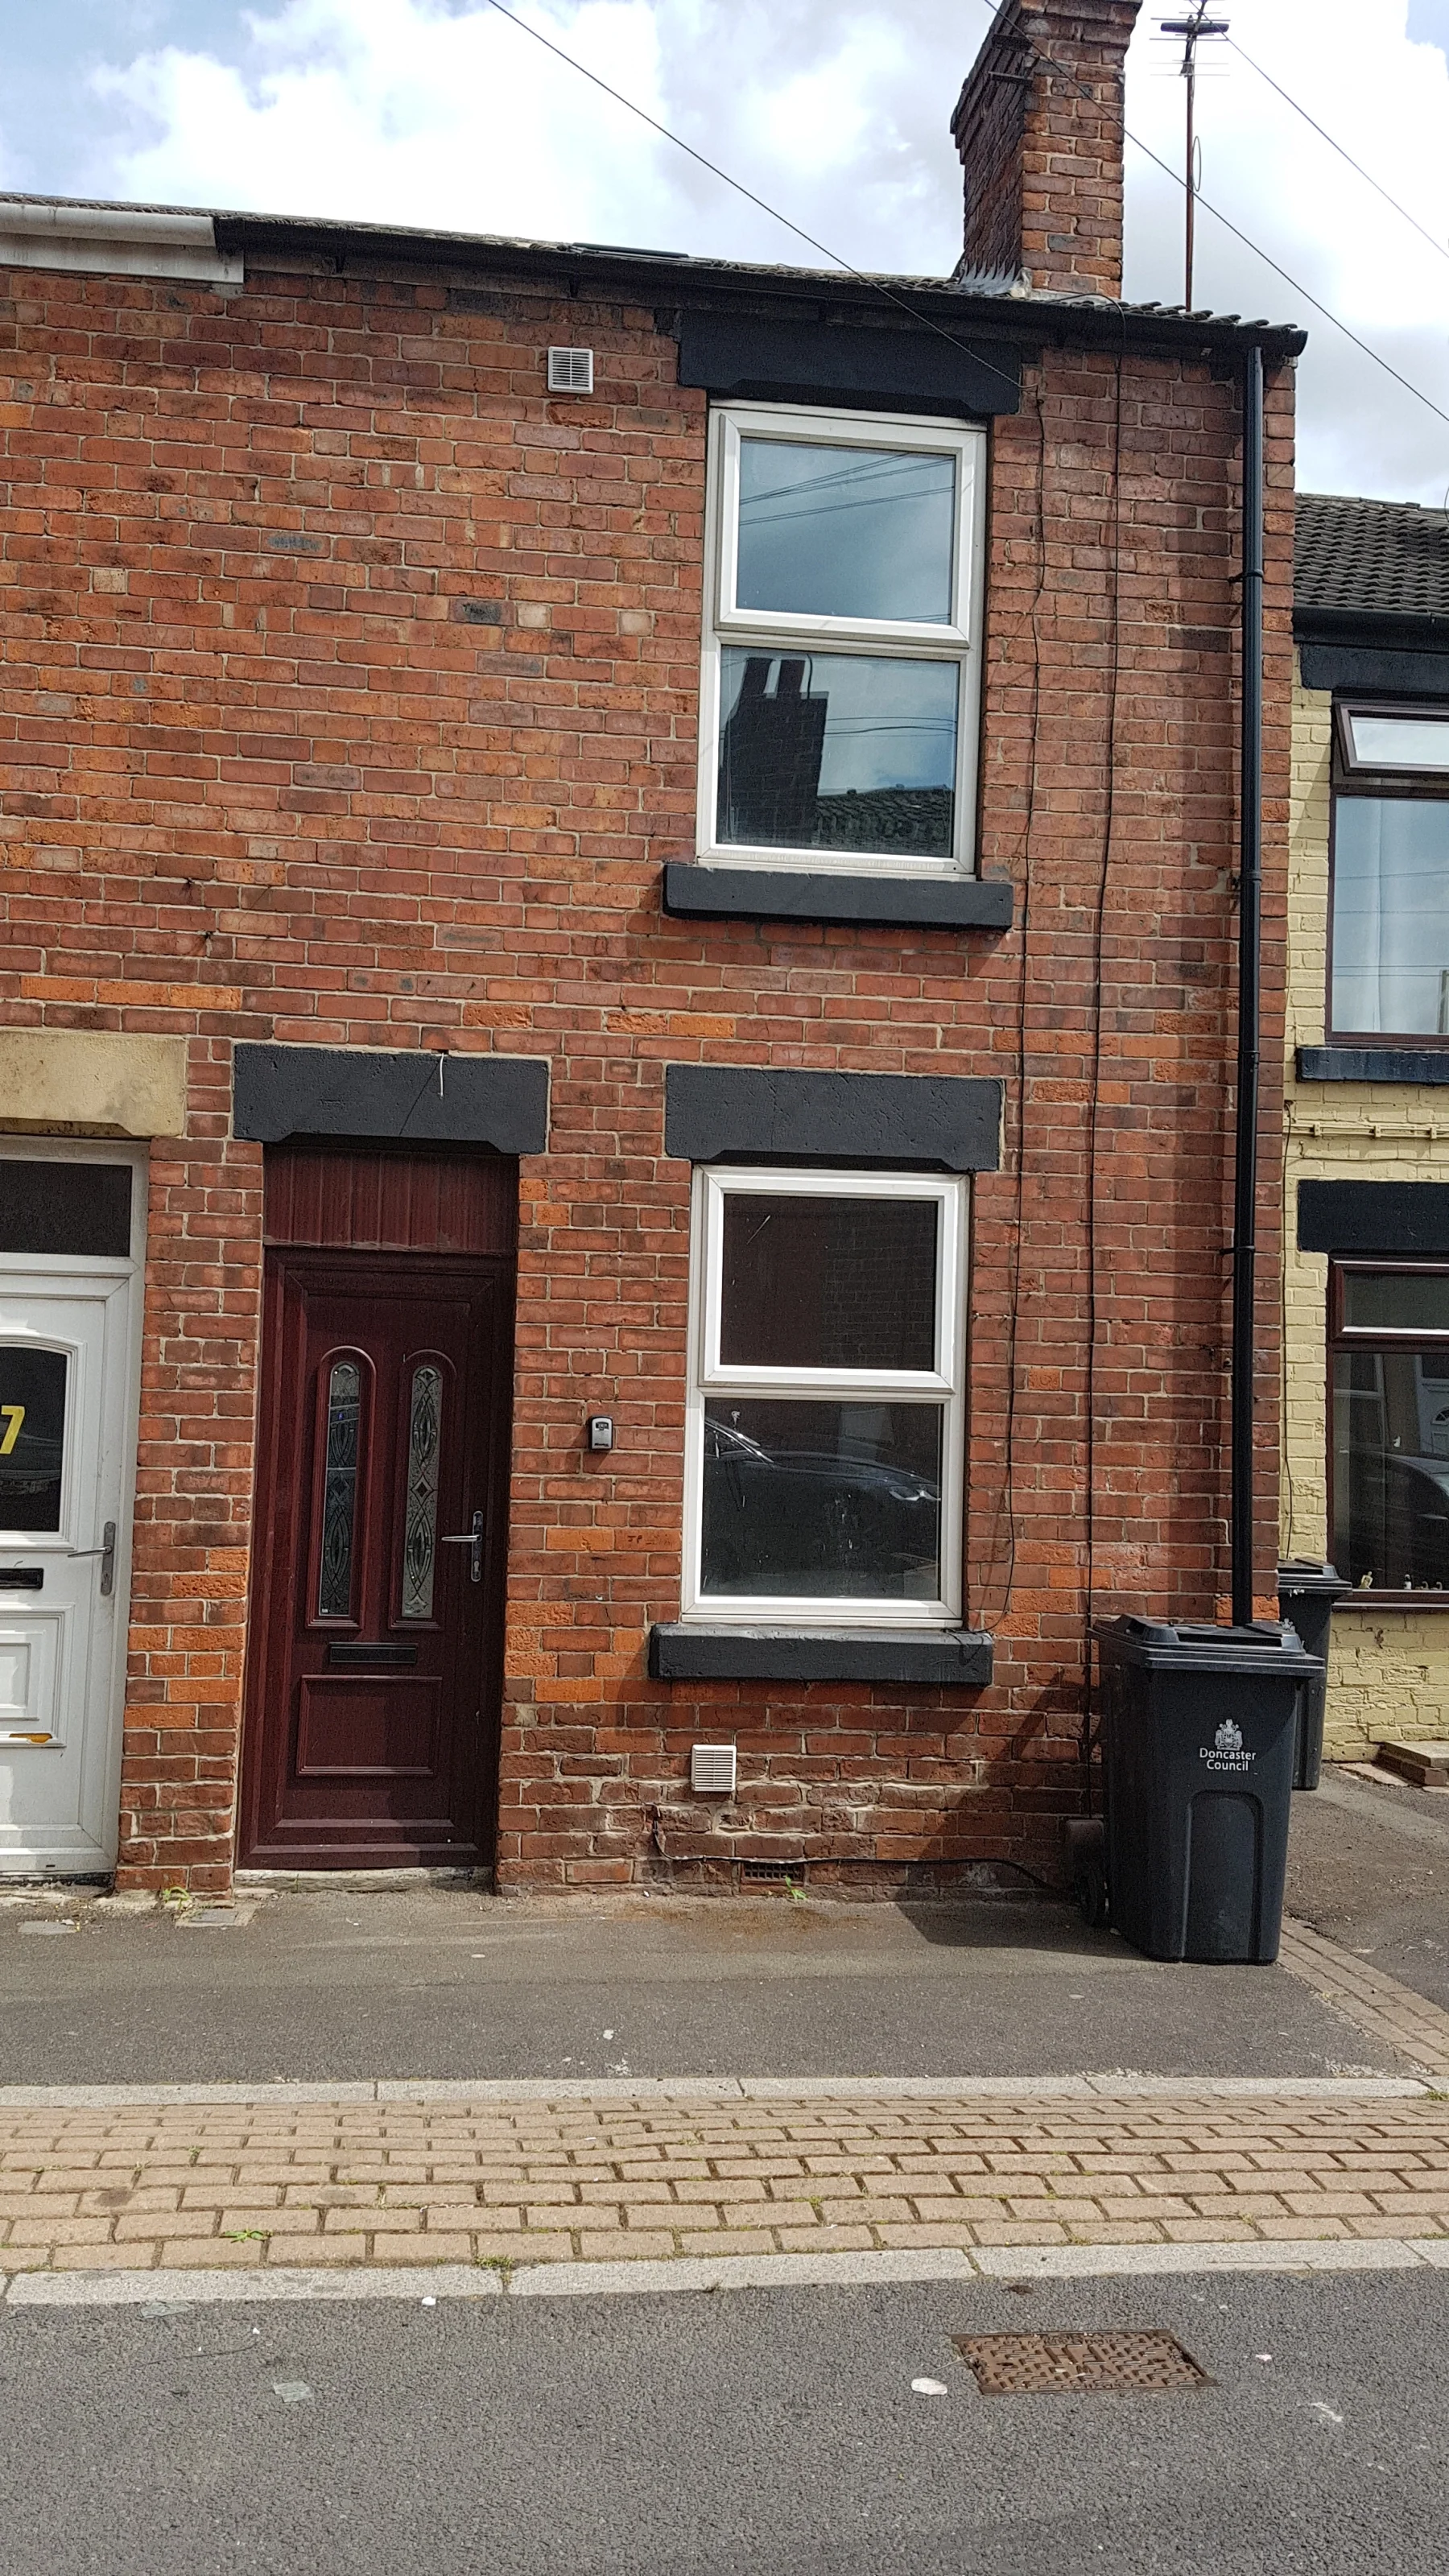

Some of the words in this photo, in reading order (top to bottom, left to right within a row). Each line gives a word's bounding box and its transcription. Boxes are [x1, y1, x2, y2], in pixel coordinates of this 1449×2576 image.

[0, 1405, 25, 1455] 7
[1199, 1748, 1256, 1760] Doncaster
[1207, 1759, 1249, 1771] Council
